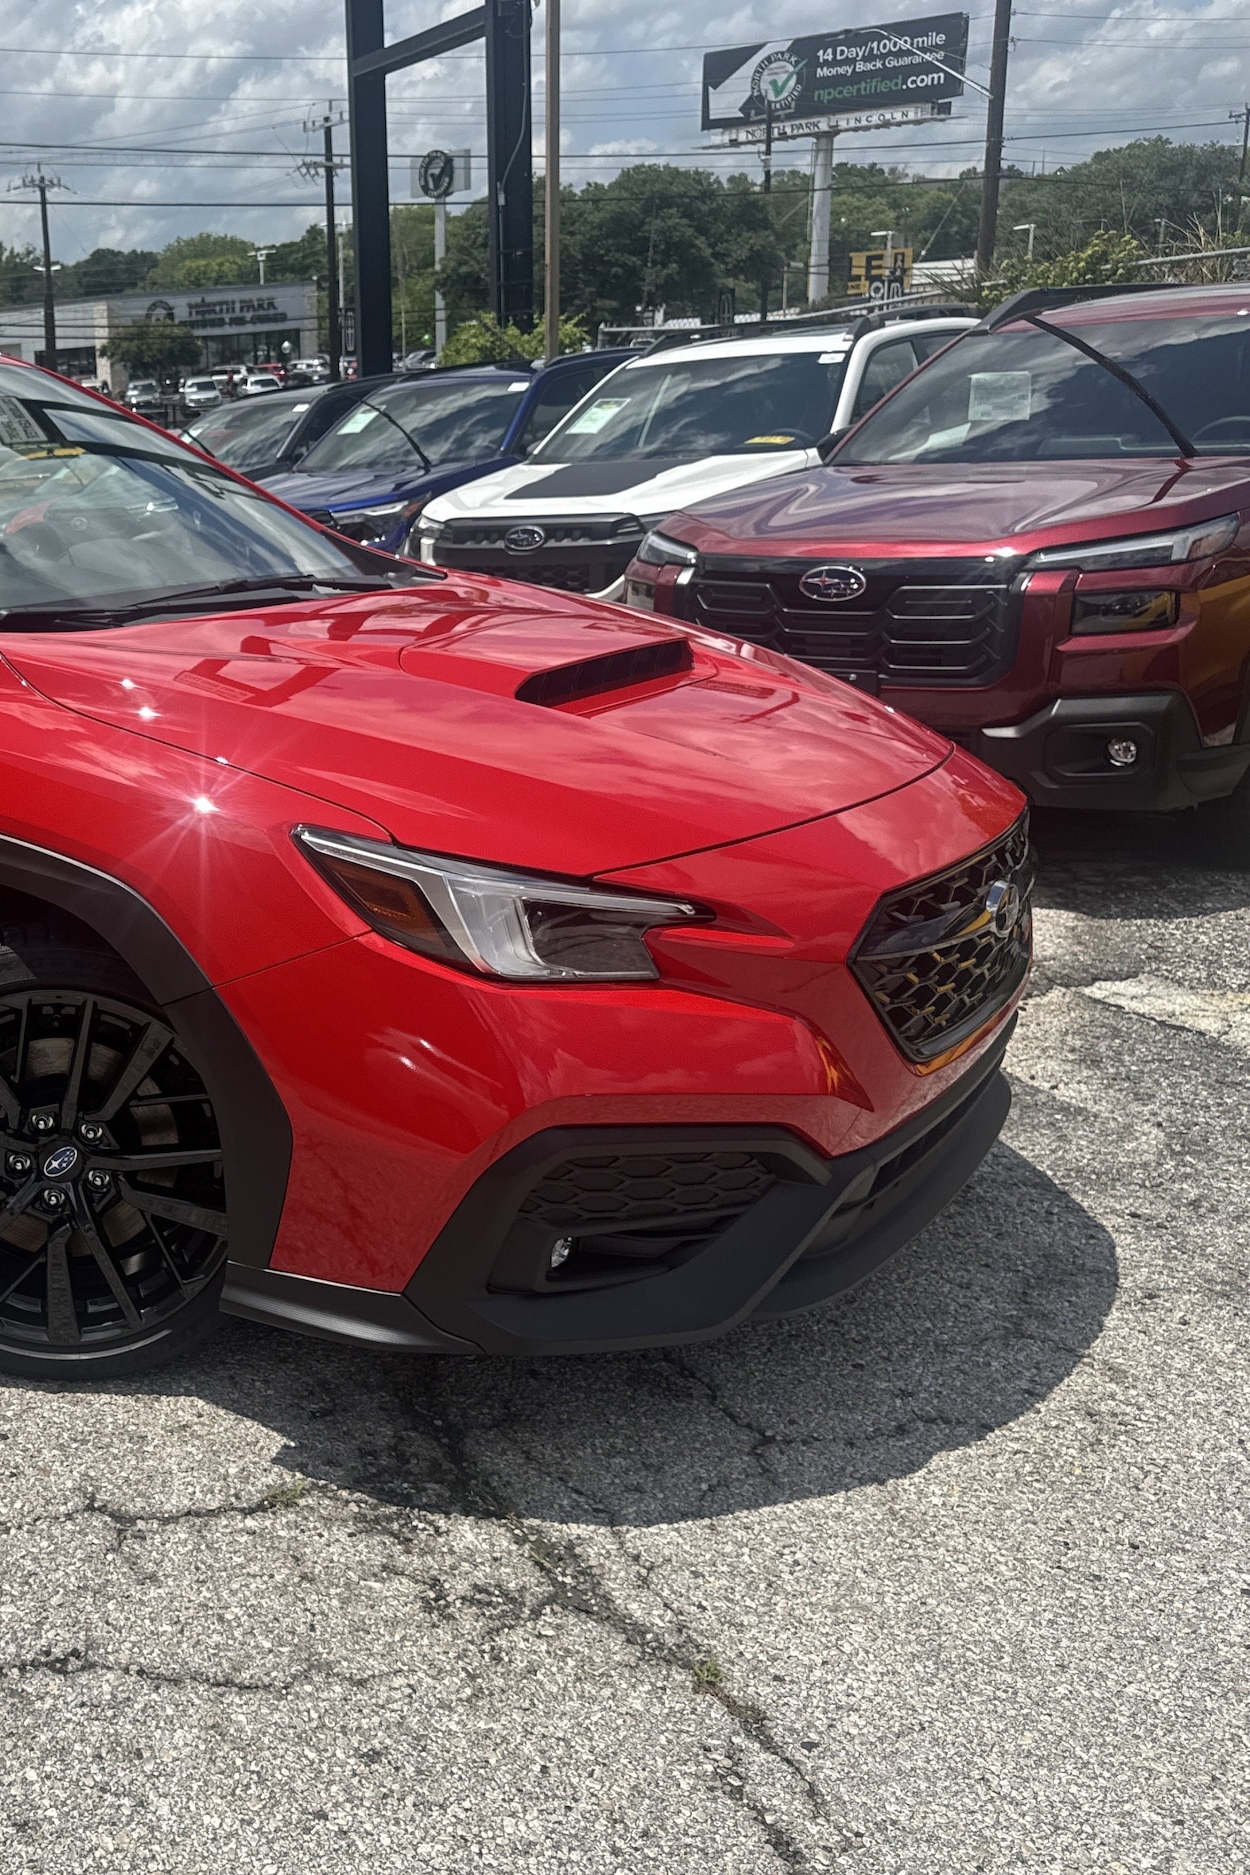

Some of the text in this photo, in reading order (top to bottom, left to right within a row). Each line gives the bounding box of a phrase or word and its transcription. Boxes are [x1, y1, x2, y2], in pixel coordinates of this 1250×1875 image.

[770, 52, 798, 66] PARK
[816, 47, 834, 63] 14
[913, 32, 946, 48] mile
[816, 51, 945, 78] Money Back Guarantee
[814, 71, 945, 103] npcertified.com
[790, 120, 821, 135] PARK
[834, 110, 909, 127] LINCOLN
[239, 297, 278, 313] PARK
